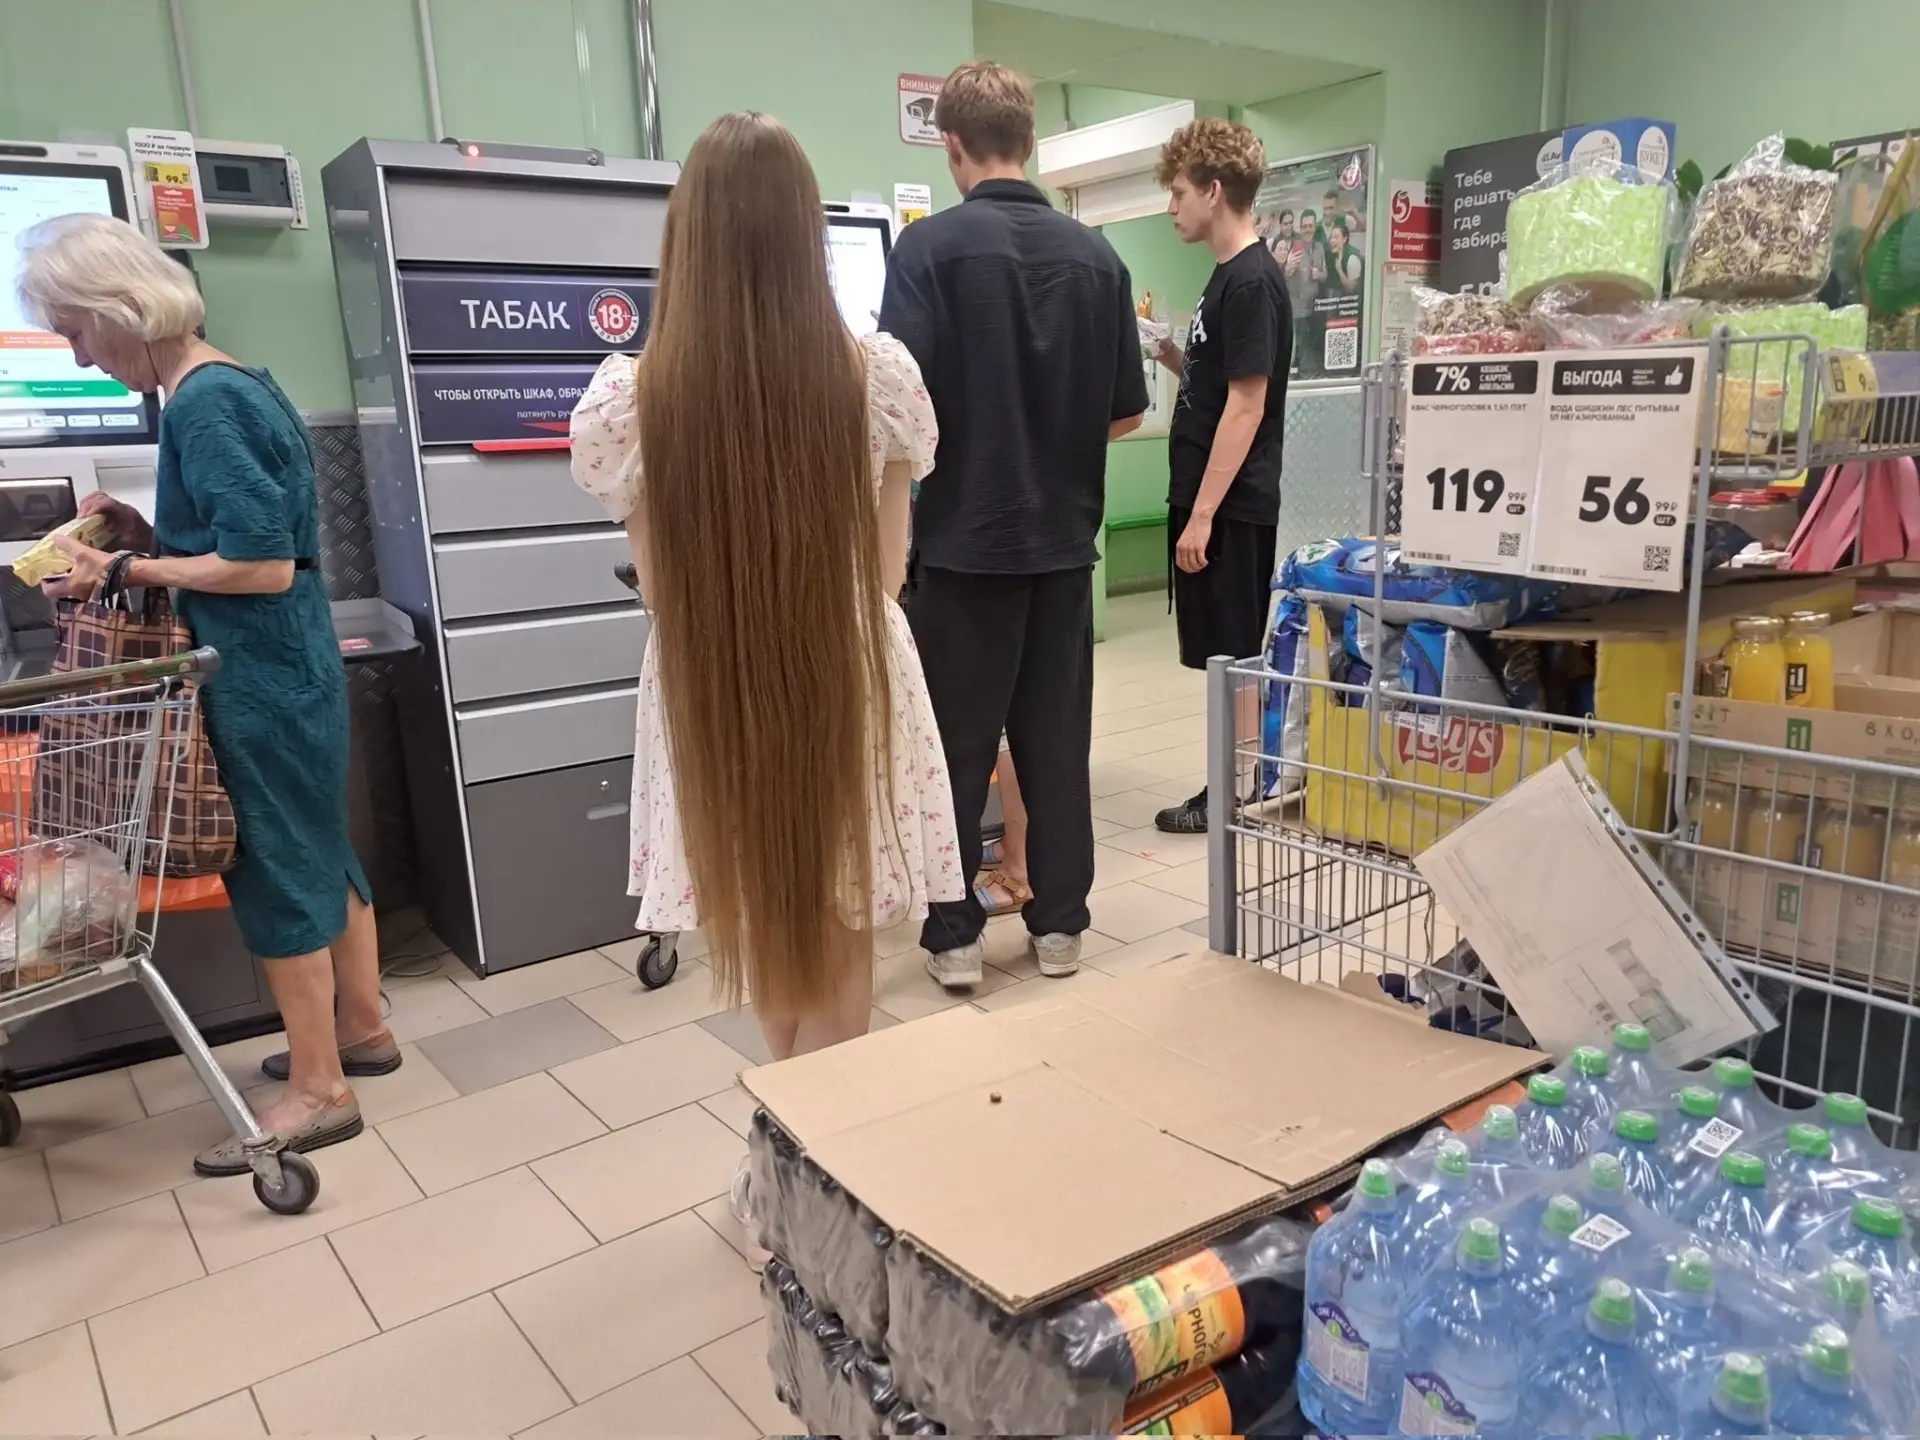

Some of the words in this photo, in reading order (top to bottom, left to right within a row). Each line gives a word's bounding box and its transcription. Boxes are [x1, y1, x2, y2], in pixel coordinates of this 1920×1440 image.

[1454, 168, 1493, 189] Тебе
[1453, 188, 1516, 213] решать
[1453, 213, 1481, 231] где
[1452, 227, 1508, 251] забира
[460, 299, 571, 330] ТАБАК
[598, 304, 631, 330] 18+
[1434, 365, 1471, 392] 7%
[1562, 369, 1623, 388] ВЫГОДА
[434, 389, 471, 401] ЧТОБЫ
[473, 388, 521, 400] ОТКРЫТЬ
[523, 387, 557, 401] ШКАФ,
[517, 410, 556, 419] потянуть
[1411, 403, 1429, 411] КВАС
[1431, 403, 1491, 411] ЧЕРНОГОЛОВКА
[1550, 404, 1573, 412] ВОДА
[1574, 404, 1616, 412] ШИШКИН
[1617, 404, 1633, 412] ЛЕС
[1635, 404, 1680, 412] ПИТЬЕВАЯ
[1561, 413, 1636, 421] НЕГАЗИРОВАННАЯ
[1426, 467, 1505, 513] 119
[1578, 475, 1650, 525] 56
[1865, 720, 1876, 736] 8
[1901, 726, 1920, 745] 0,
[1183, 1284, 1209, 1366] РНОГО
